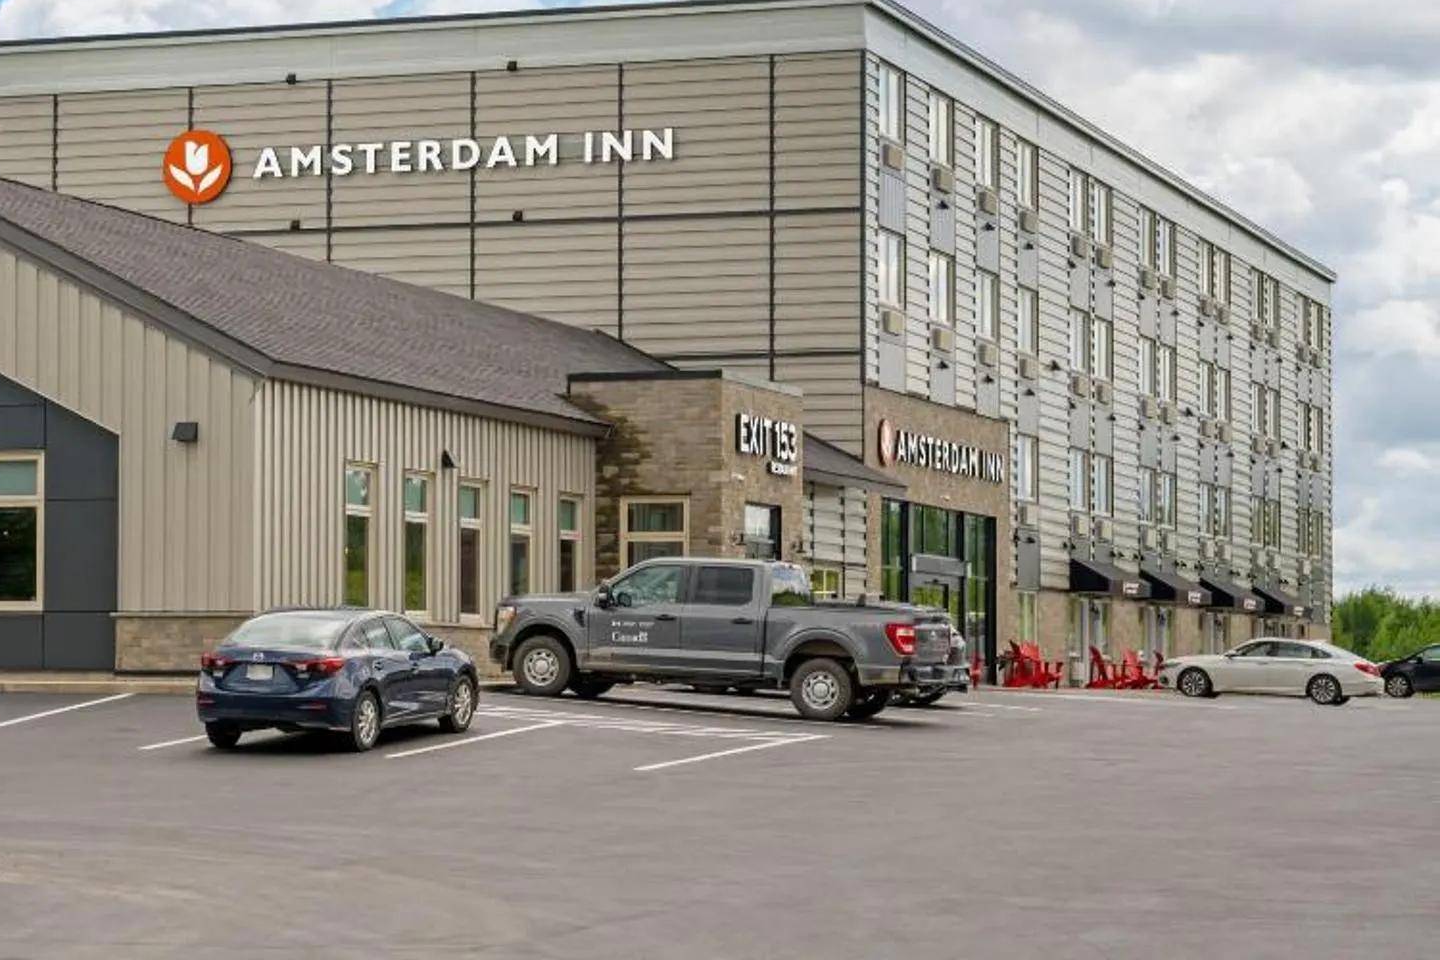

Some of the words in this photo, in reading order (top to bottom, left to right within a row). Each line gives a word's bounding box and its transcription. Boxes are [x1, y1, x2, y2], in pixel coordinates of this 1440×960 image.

[253, 133, 558, 178] AMSTERDAM
[584, 127, 673, 162] INN
[740, 413, 773, 458] EXIT
[774, 421, 797, 461] 153
[897, 429, 979, 477] AMSTERDAM
[982, 449, 1005, 482] INN
